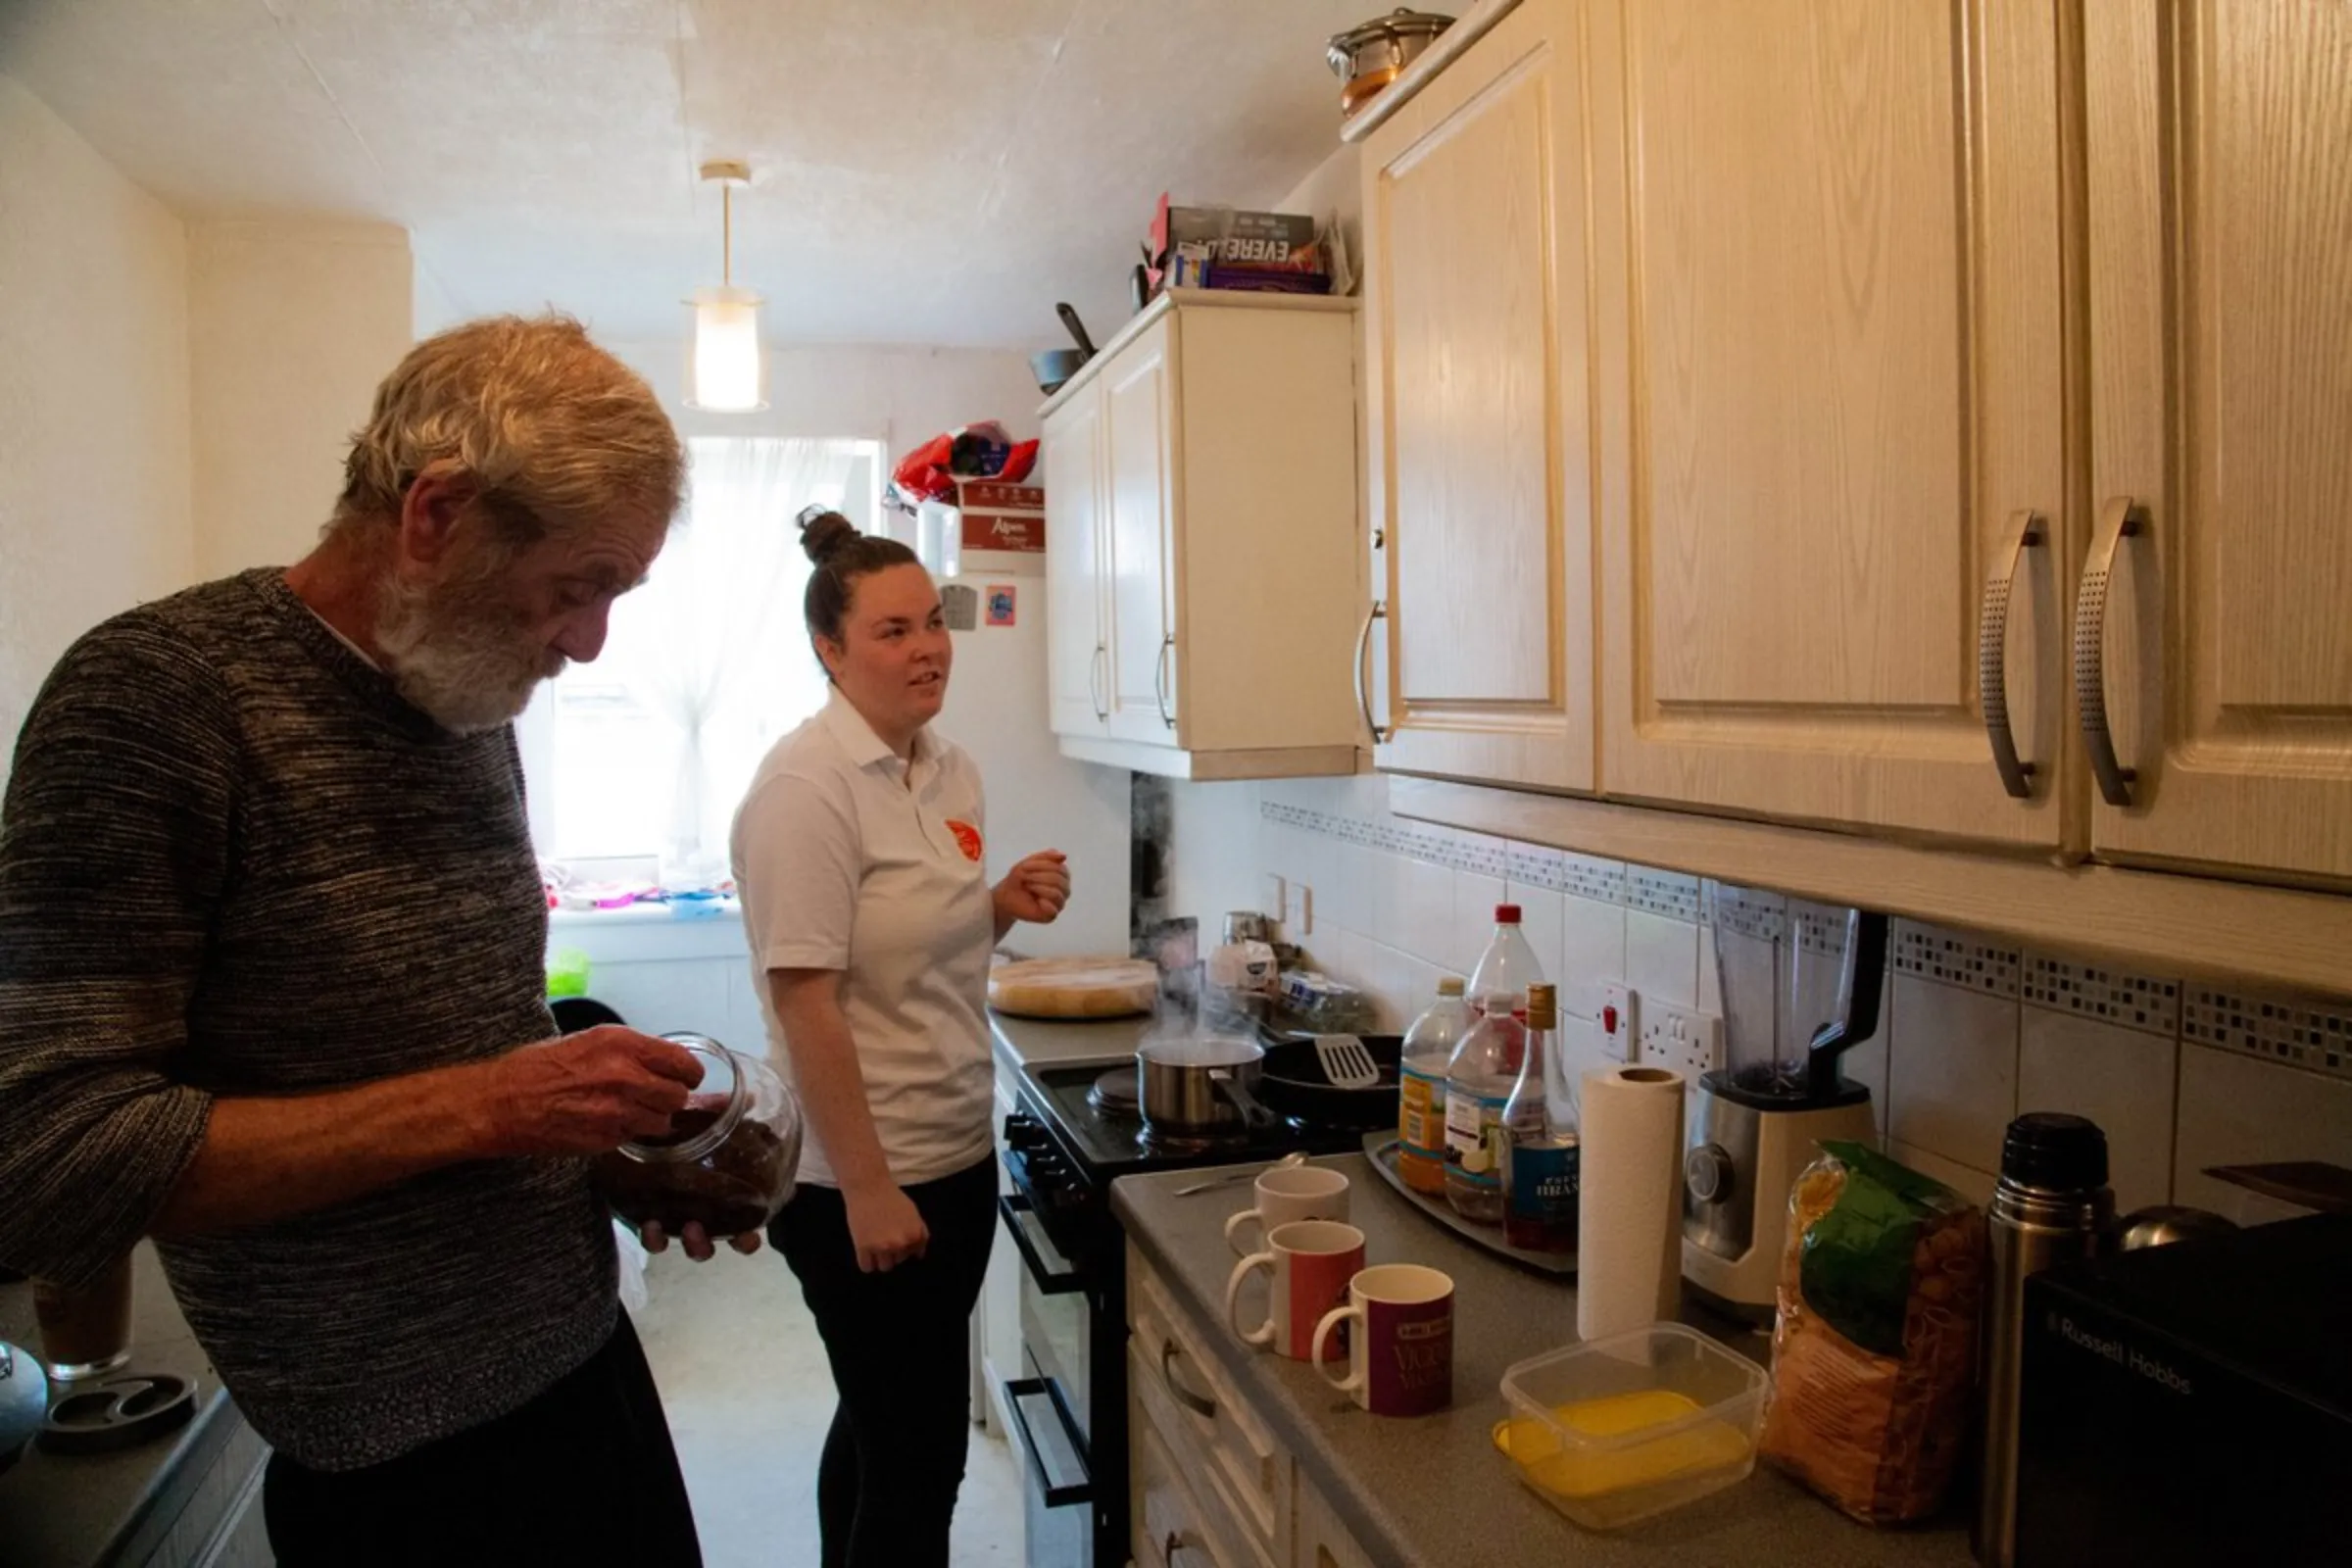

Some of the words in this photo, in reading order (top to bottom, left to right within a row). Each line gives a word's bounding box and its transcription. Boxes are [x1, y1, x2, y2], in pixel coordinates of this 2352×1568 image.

[1198, 239, 1290, 263] EVERED
[1537, 1184, 1578, 1196] BRAN
[2062, 1317, 2123, 1365] Russell
[2130, 1347, 2191, 1395] Hobbs
